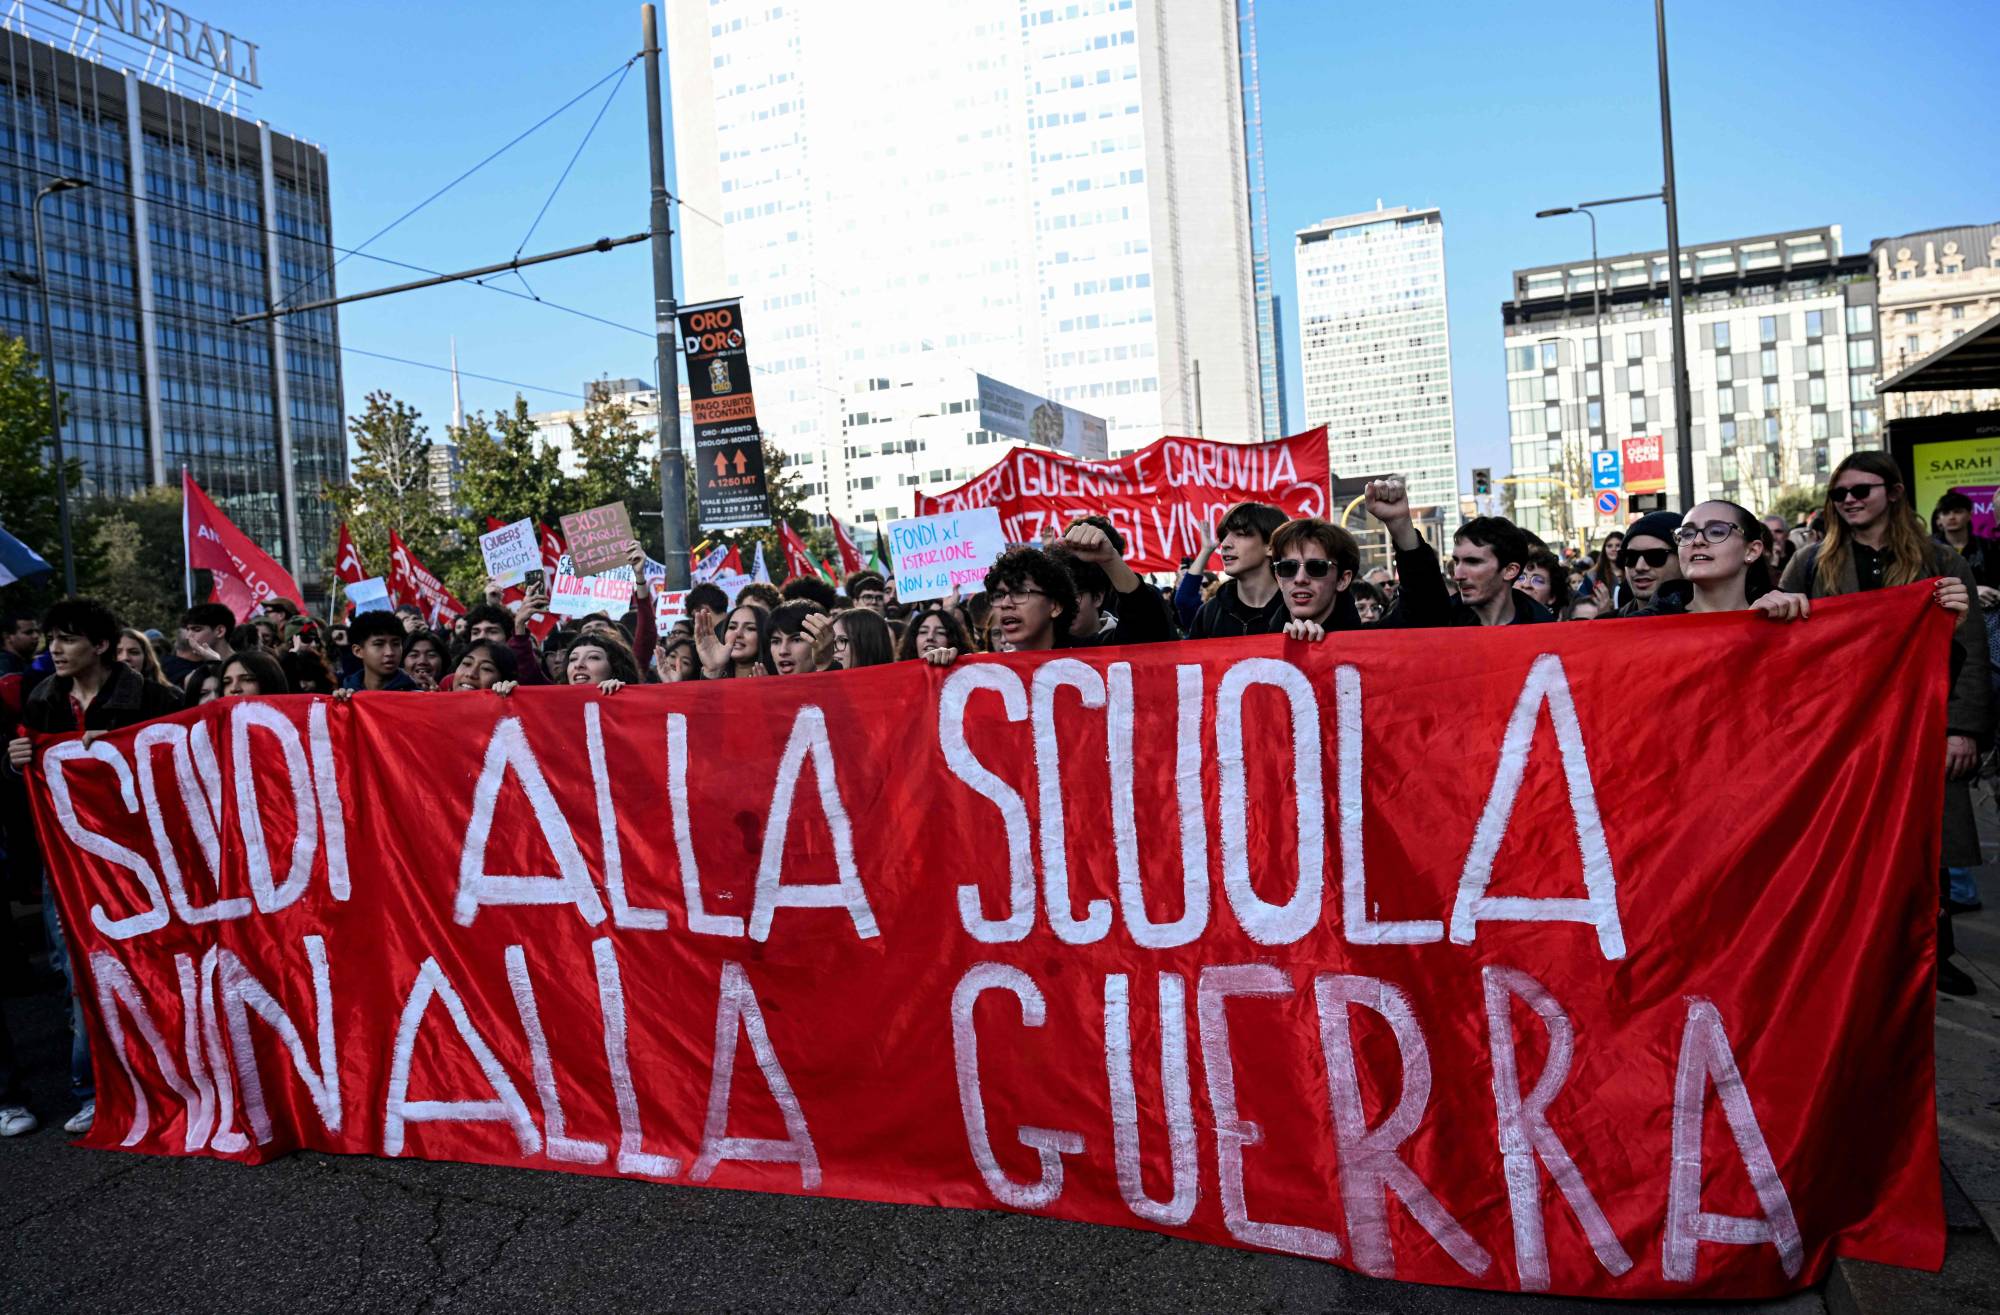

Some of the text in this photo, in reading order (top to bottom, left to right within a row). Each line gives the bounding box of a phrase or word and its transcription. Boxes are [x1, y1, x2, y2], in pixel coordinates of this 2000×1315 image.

[58, 0, 262, 89] NERALI
[690, 309, 732, 332] ORO
[685, 329, 743, 354] D'ORO
[695, 397, 752, 412] PAGO SUBITO
[697, 406, 752, 420] IN CONTANTI
[697, 434, 759, 448] OROLOGI MONETE
[702, 425, 752, 437] ORO ARGENTO
[1627, 446, 1659, 456] OPEN
[1628, 453, 1659, 463] TOUR
[1017, 452, 1133, 497] GUERRA
[1134, 452, 1157, 494] E
[1163, 441, 1298, 492] CAROVITA
[1597, 453, 1614, 473] P
[1930, 456, 1992, 472] SARAH
[708, 479, 716, 488] A
[742, 475, 756, 485] MT
[701, 498, 720, 506] VIALE
[563, 508, 617, 536] EXISTO
[1151, 502, 1231, 560] VINC
[484, 527, 520, 551] QUEERS
[571, 524, 625, 552] PORQUE
[489, 540, 523, 560] AGAINST
[902, 541, 976, 570] ISTRUZIONE
[492, 551, 530, 575] FASCISM
[898, 574, 922, 594] NON
[936, 573, 948, 587] LA
[453, 701, 882, 943] ALLA
[939, 653, 1627, 960] SCUOLA
[383, 935, 824, 1191] ALLA
[950, 960, 1804, 1292] GUERRA
